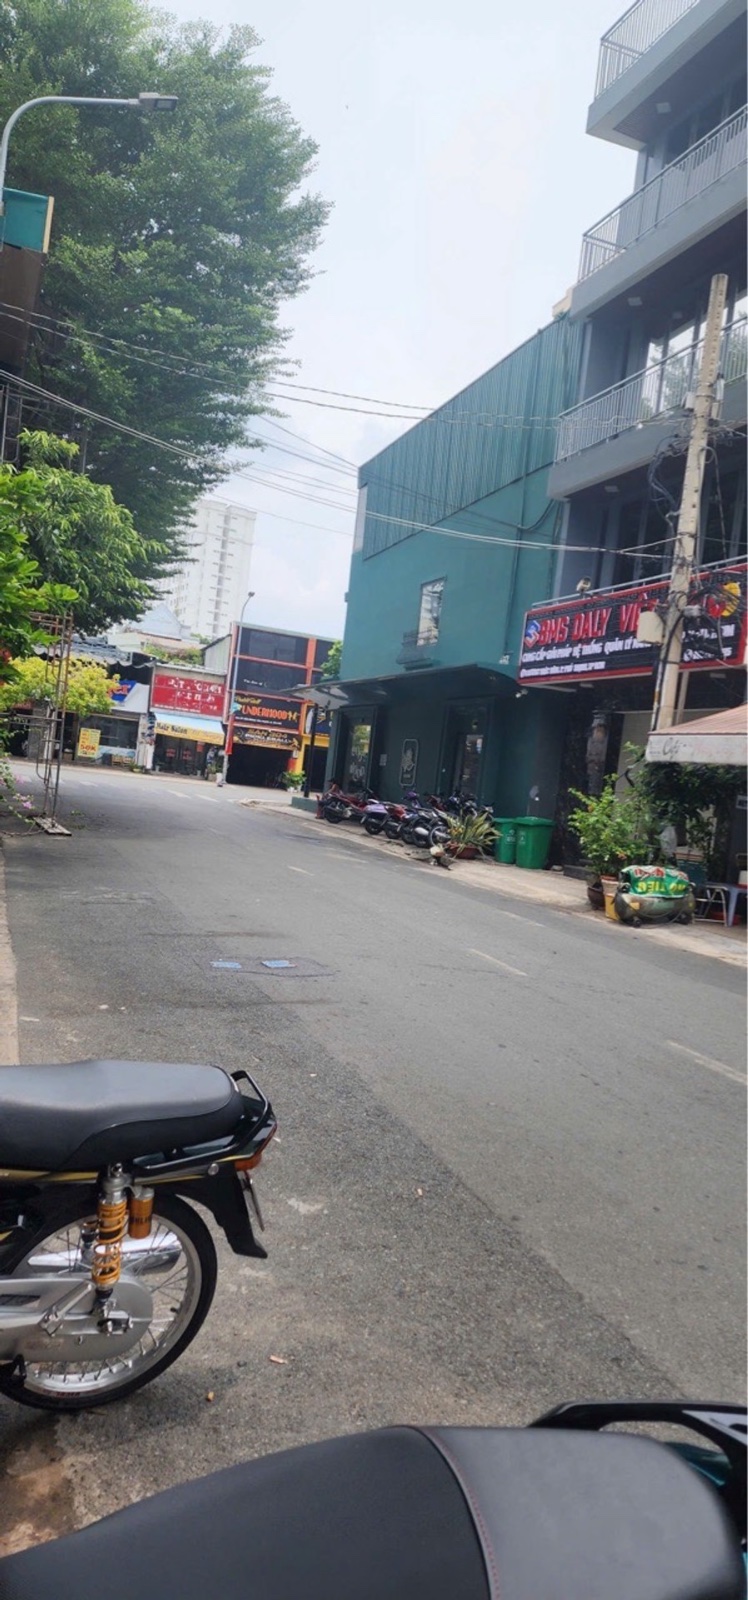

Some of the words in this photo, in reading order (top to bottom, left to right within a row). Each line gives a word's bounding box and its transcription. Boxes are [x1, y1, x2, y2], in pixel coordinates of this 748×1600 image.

[538, 615, 570, 645] BMS
[572, 607, 612, 641] DALY
[242, 704, 288, 721] UNDERHOOD
